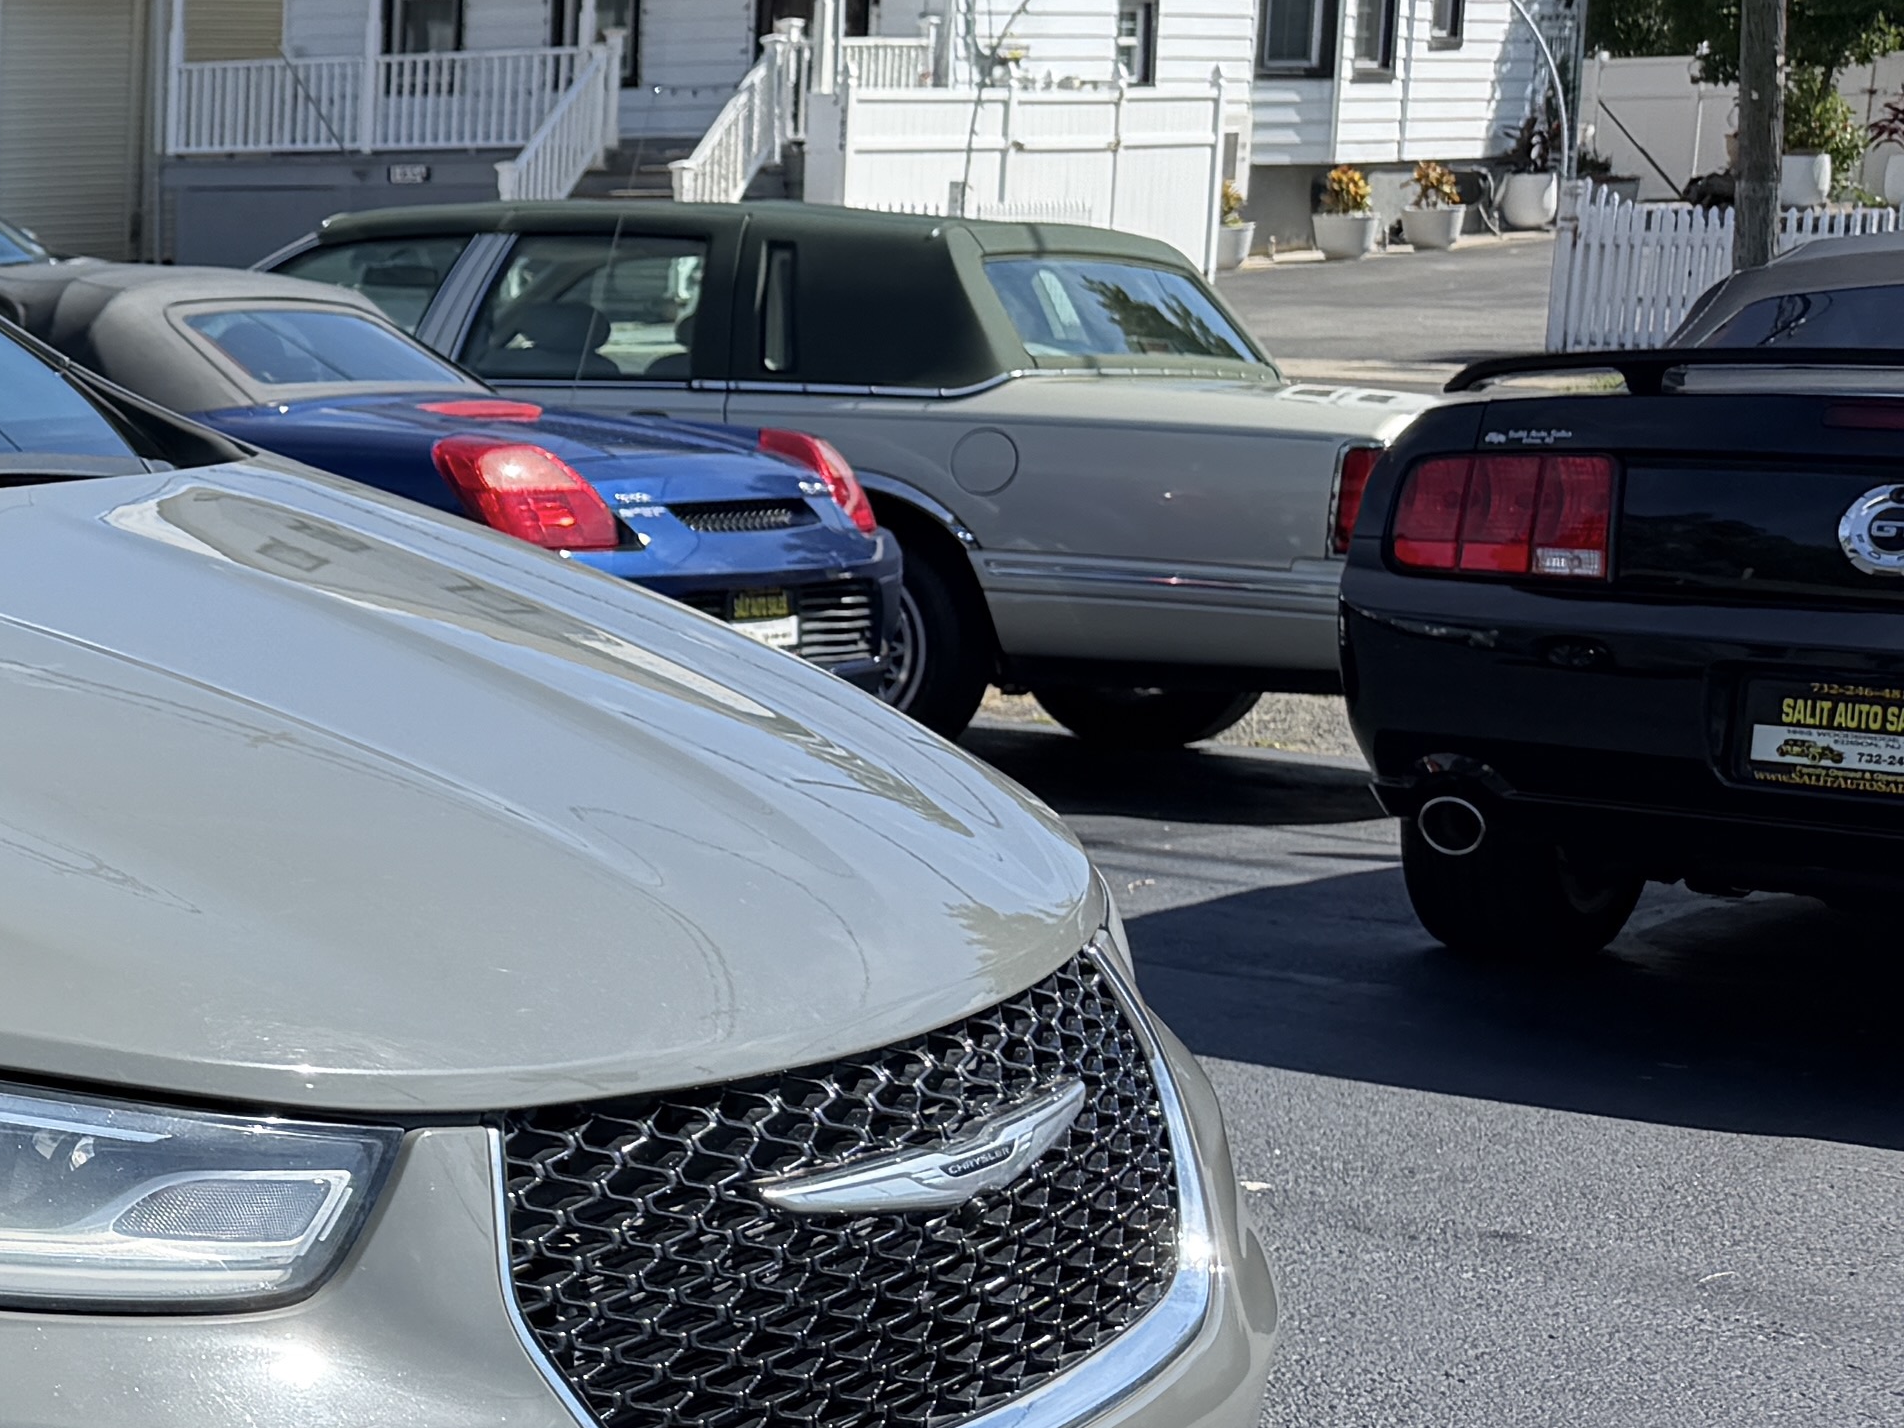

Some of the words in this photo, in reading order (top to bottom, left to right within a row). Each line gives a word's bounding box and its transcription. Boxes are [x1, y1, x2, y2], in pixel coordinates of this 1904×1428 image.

[1781, 697, 1833, 726] SALIT
[1833, 702, 1883, 730] AUTO
[948, 1147, 1010, 1174] CHRYSLER
